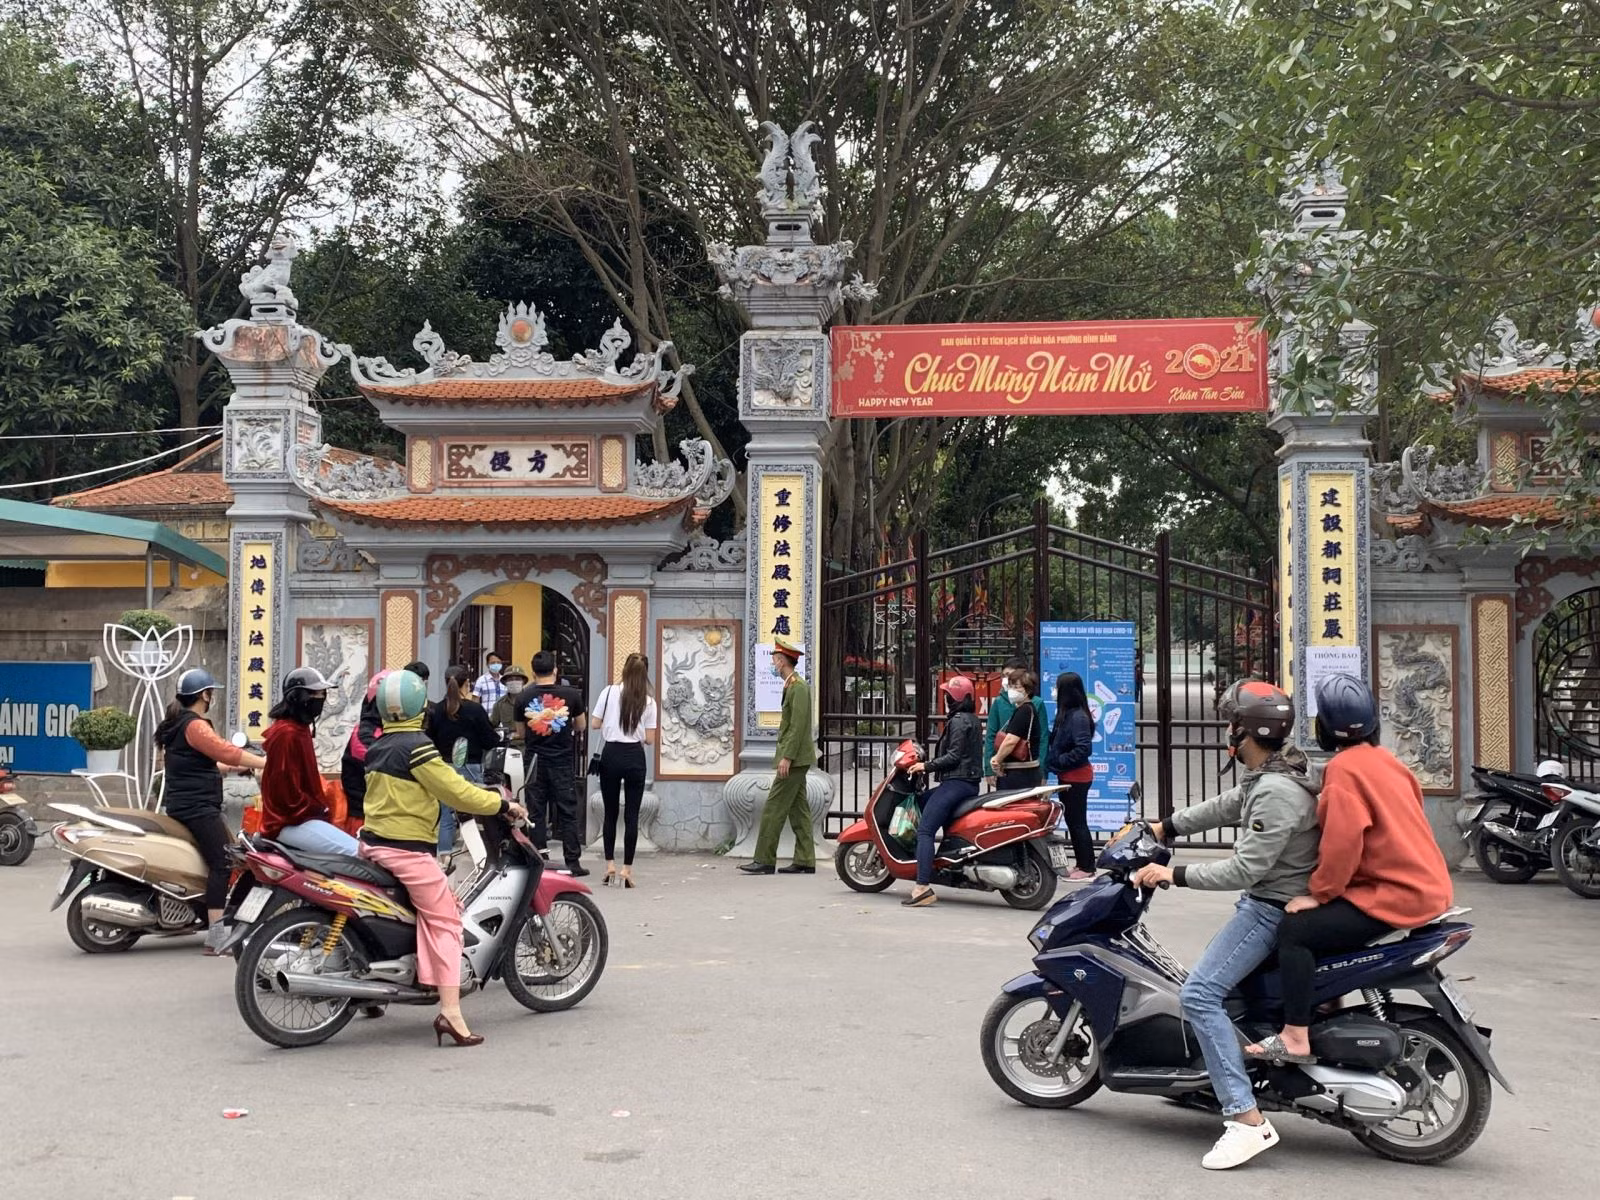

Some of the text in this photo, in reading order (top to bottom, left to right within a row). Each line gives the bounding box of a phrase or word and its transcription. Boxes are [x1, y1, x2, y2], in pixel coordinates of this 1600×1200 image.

[941, 338, 954, 347] BAN
[955, 336, 972, 347] QUẢN
[904, 350, 1157, 404] Chúc Mừng Năm Mới
[858, 397, 933, 407] HAPPY NEW YEAR
[1168, 385, 1198, 404] Xuân
